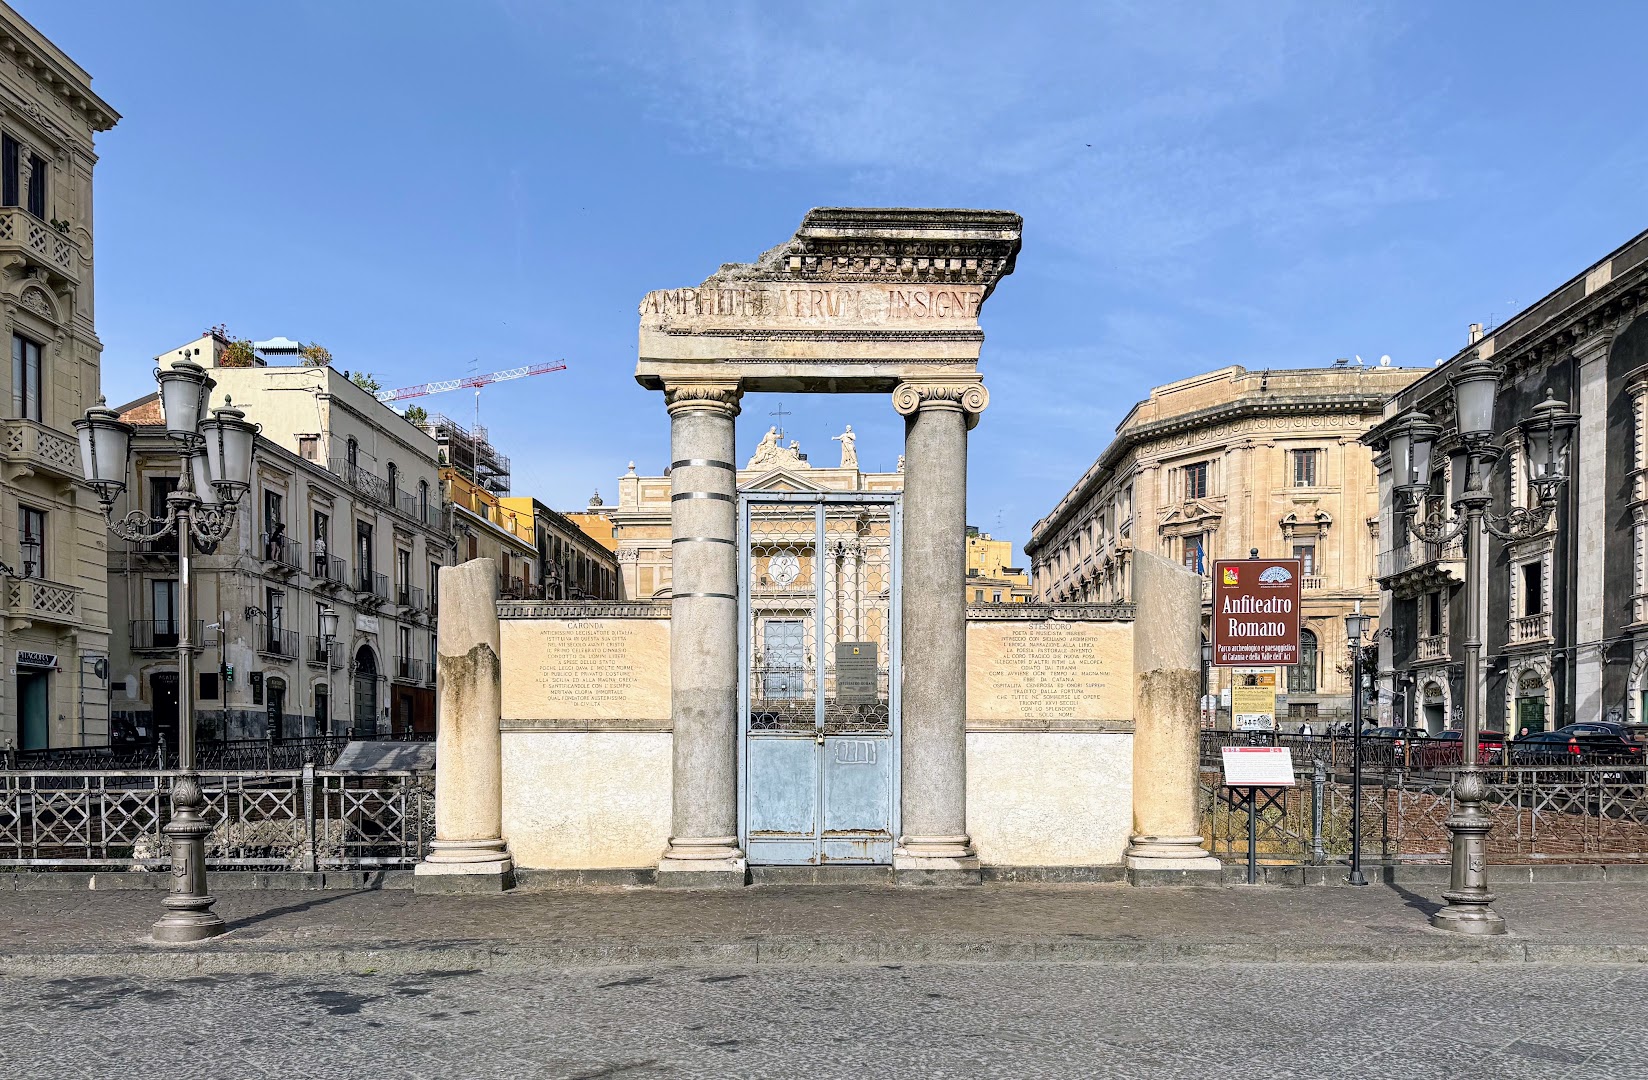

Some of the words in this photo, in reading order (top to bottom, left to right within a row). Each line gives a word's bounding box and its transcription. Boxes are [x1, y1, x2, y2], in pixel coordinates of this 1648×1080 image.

[888, 290, 981, 318] INSIGNE
[1222, 594, 1292, 614] Anfiteatro
[1228, 618, 1286, 637] Romano
[1218, 644, 1231, 652] Parco
[1232, 644, 1260, 652] archeologico
[1265, 644, 1295, 652] paesaggistico
